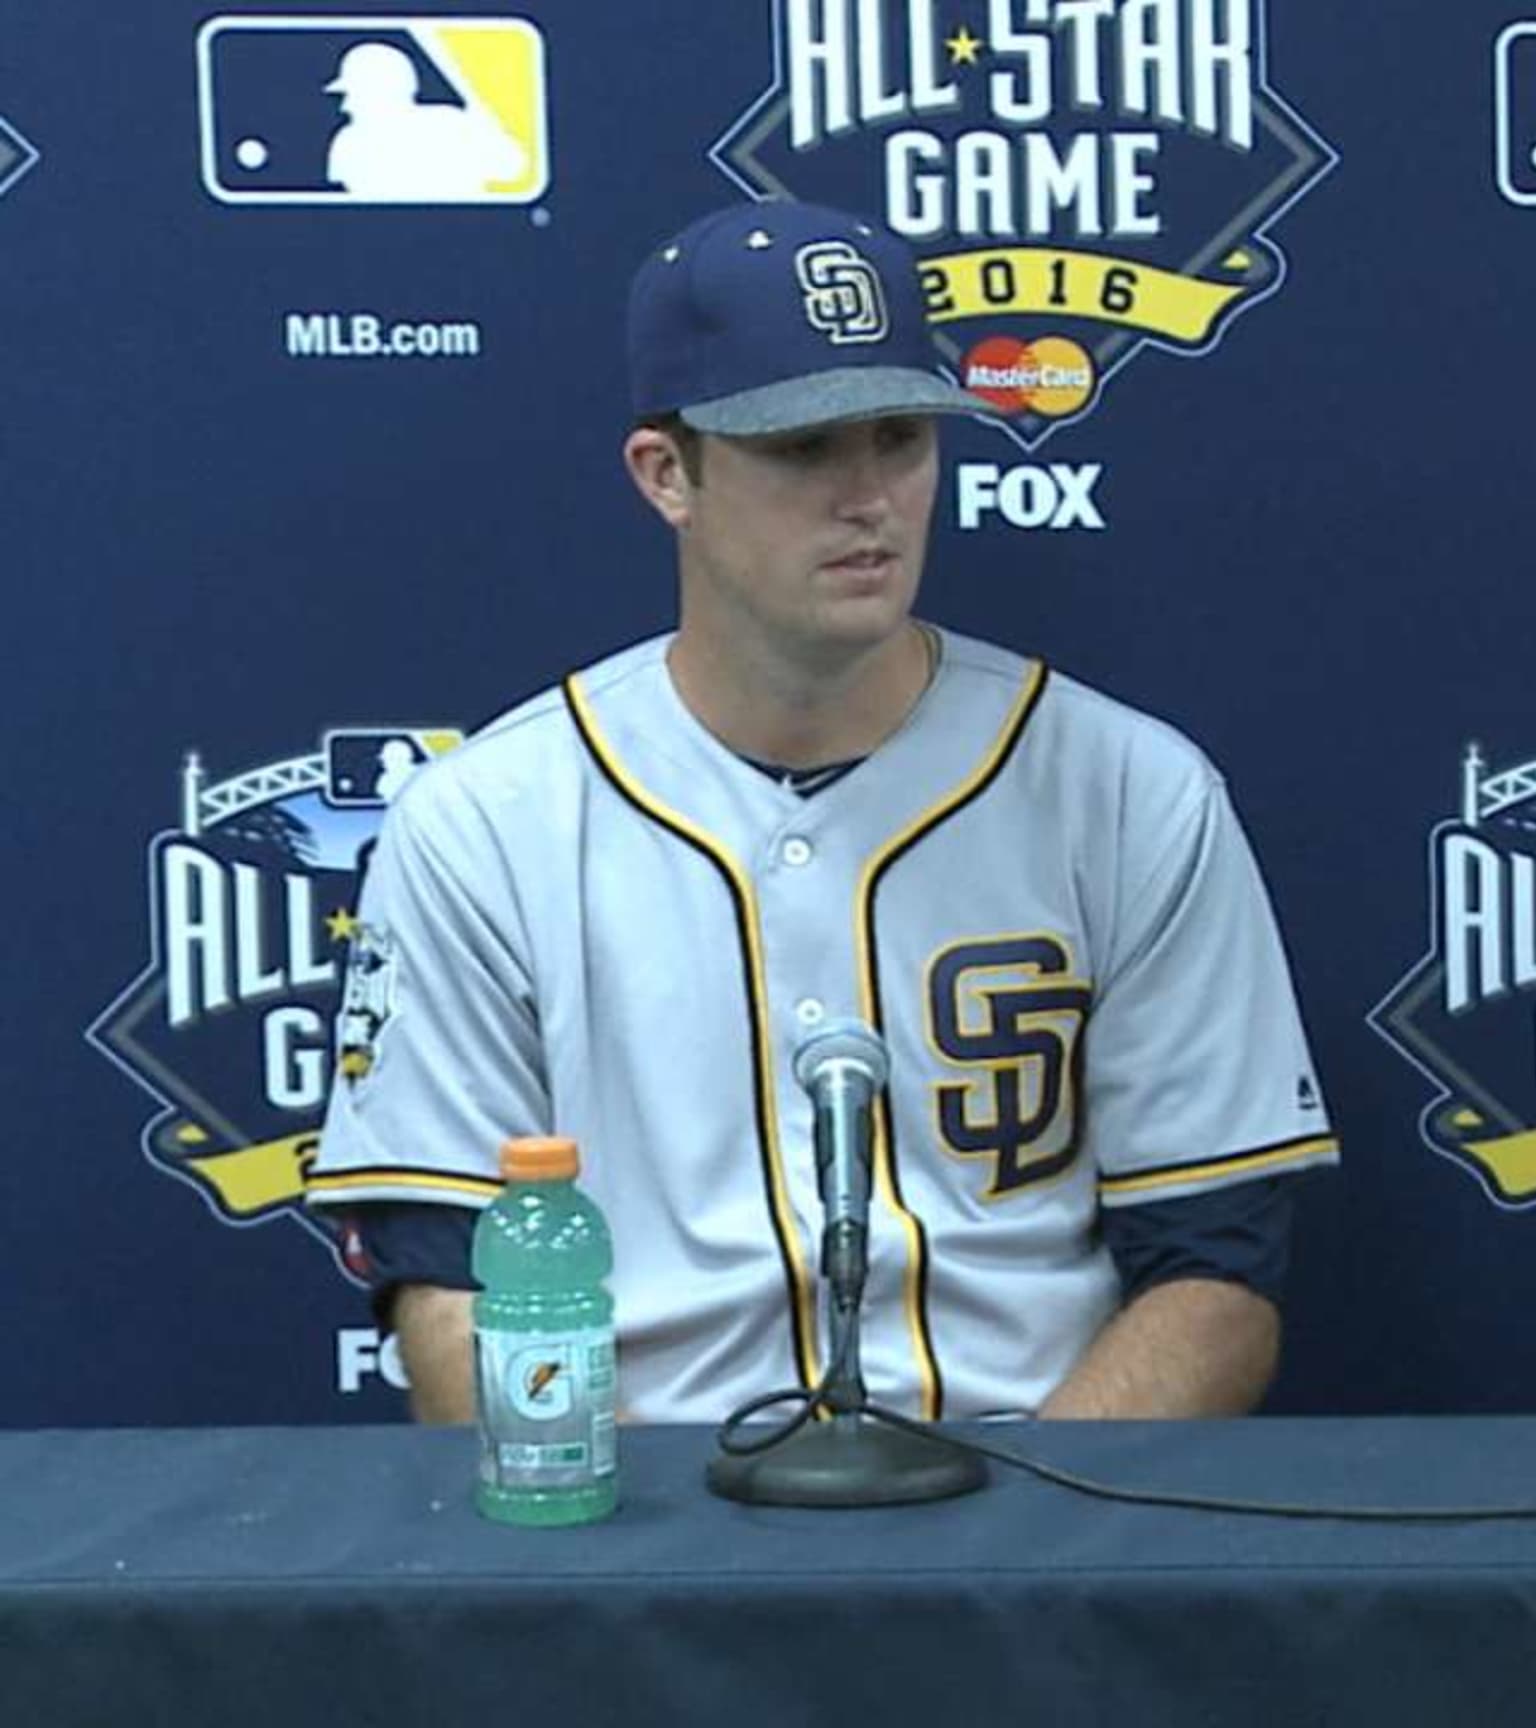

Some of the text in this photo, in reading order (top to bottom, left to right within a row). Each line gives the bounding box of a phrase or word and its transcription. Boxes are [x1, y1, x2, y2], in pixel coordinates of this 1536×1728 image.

[886, 130, 1161, 236] GAME
[286, 314, 480, 356] MLB.com
[958, 464, 1105, 529] FOX
[163, 843, 335, 1027] ALL
